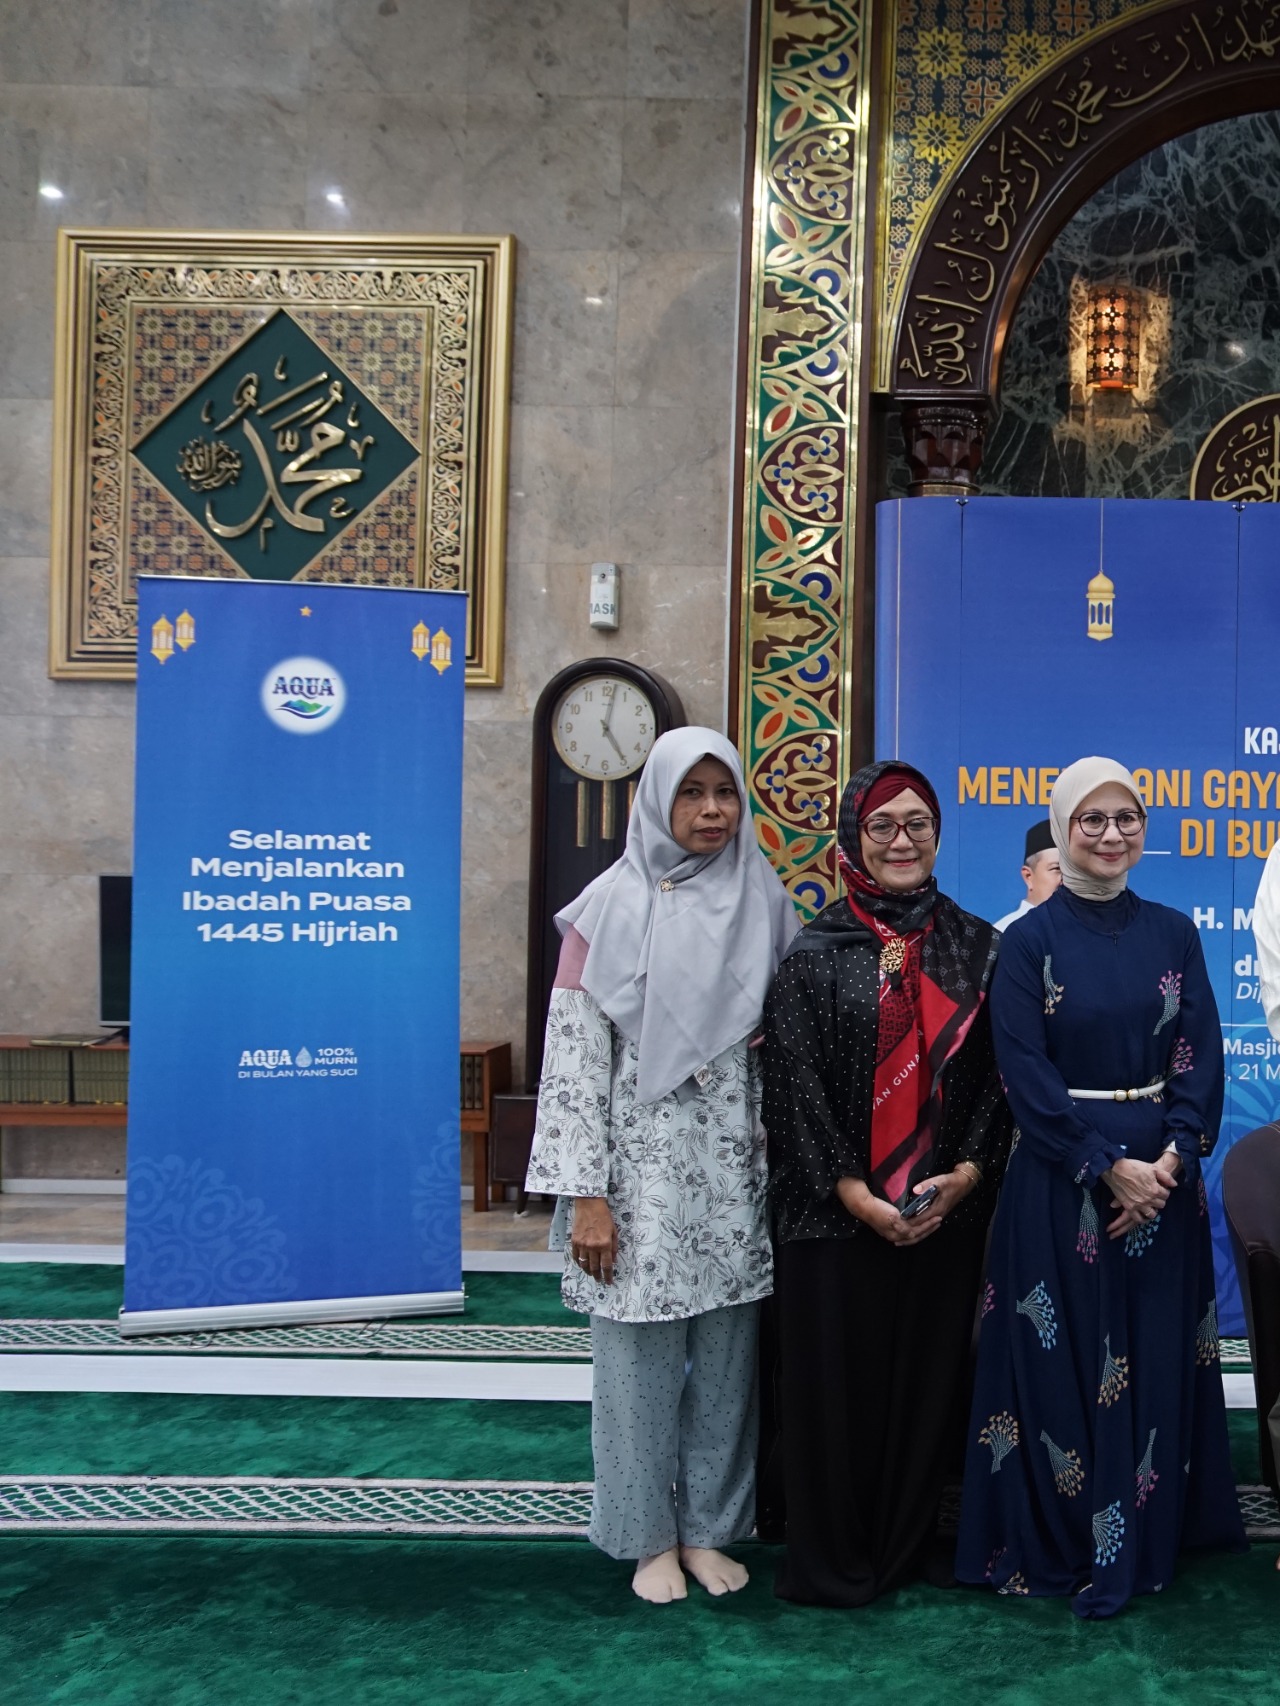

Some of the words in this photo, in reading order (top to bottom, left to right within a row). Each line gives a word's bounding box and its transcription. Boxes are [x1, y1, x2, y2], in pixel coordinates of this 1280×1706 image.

[272, 676, 335, 699] AQUA
[229, 829, 371, 850] Selamat
[1180, 818, 1215, 857] DI
[190, 857, 405, 882] Menjalankan
[182, 890, 300, 911] Ibadah
[308, 892, 412, 912] Puasa
[197, 922, 284, 942] 1445
[292, 921, 398, 947] Hijriah
[238, 1049, 293, 1069] AQUA
[314, 1056, 357, 1065] MURNI
[317, 1048, 354, 1056] 100%
[238, 1070, 250, 1079] DI
[252, 1070, 294, 1078] BULAN
[295, 1069, 328, 1077] YANG
[330, 1068, 358, 1077] SUCI
[1238, 1063, 1259, 1080] 21
